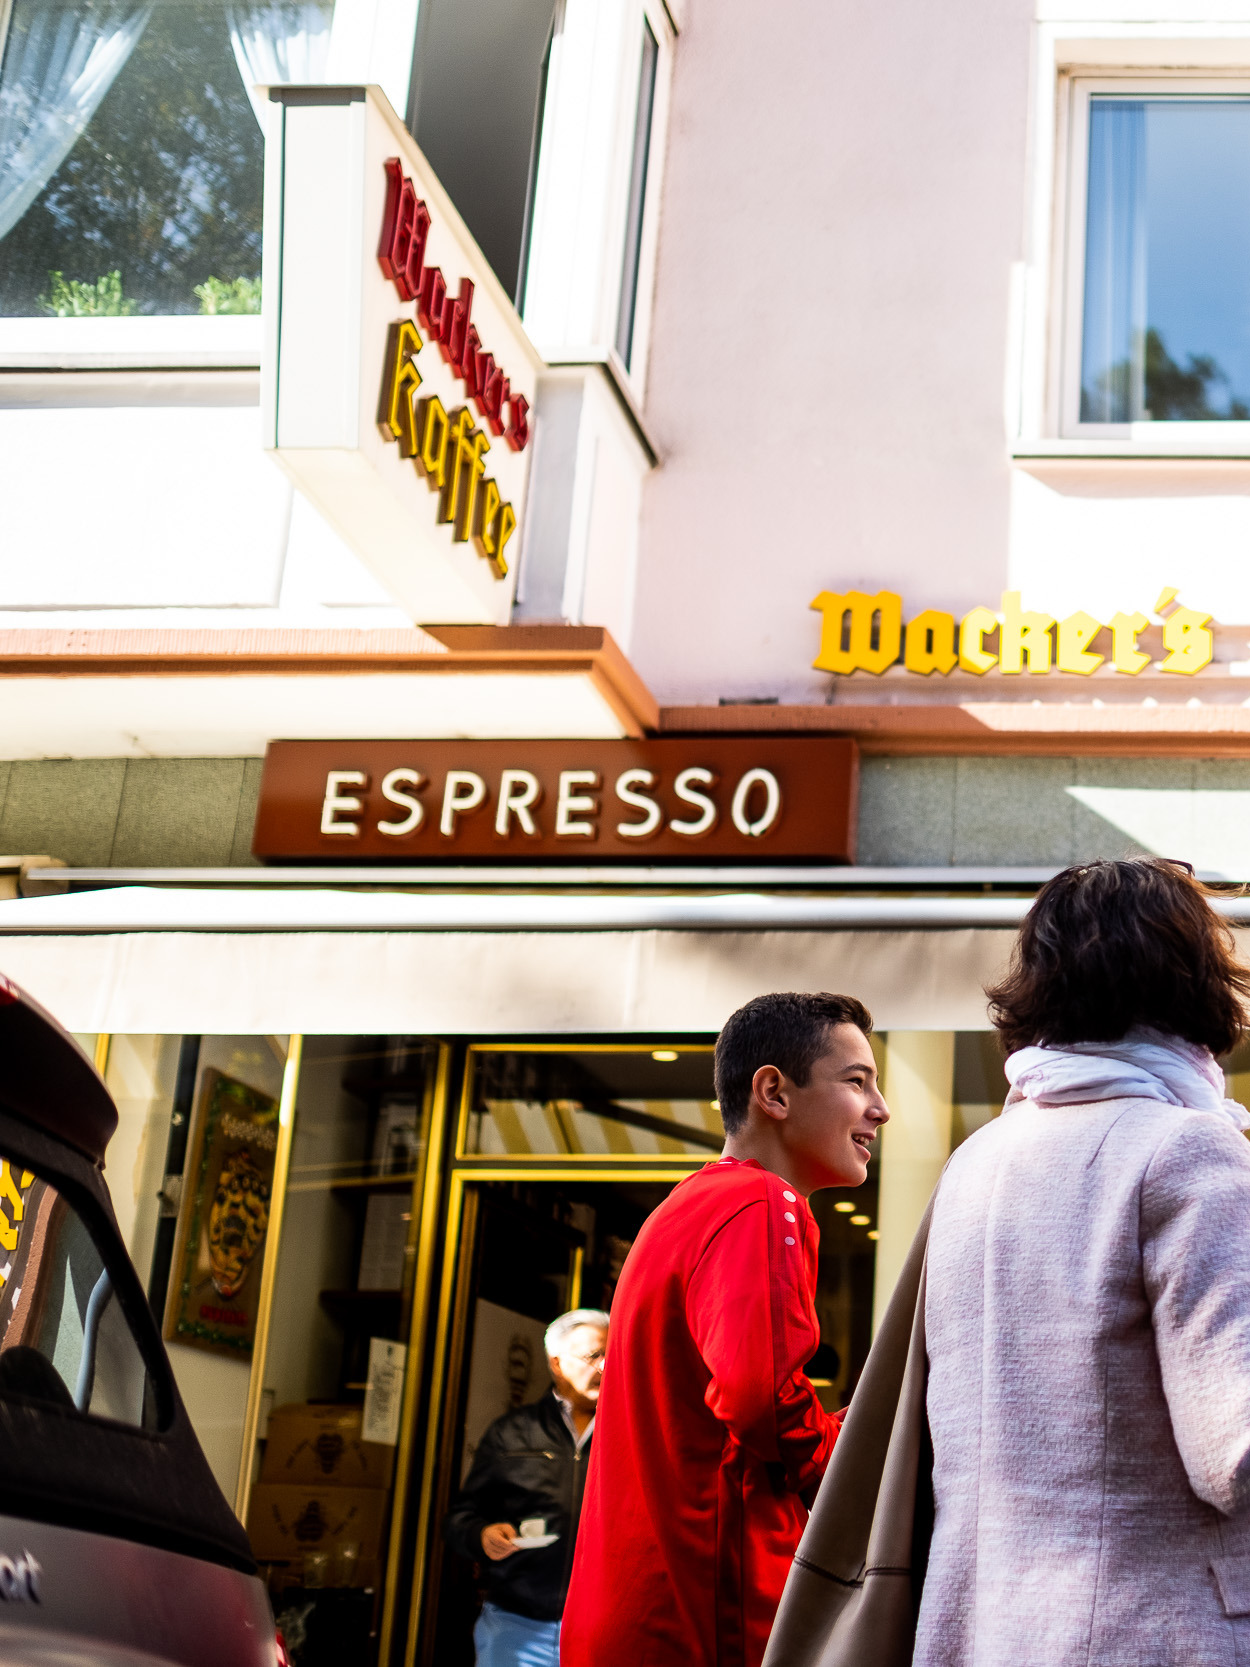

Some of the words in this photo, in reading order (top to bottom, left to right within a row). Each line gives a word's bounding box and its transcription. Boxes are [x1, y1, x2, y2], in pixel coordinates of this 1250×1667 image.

[377, 319, 517, 580] Kaffee
[810, 586, 1213, 676] Wacker's
[320, 767, 781, 838] ESPRESSO
